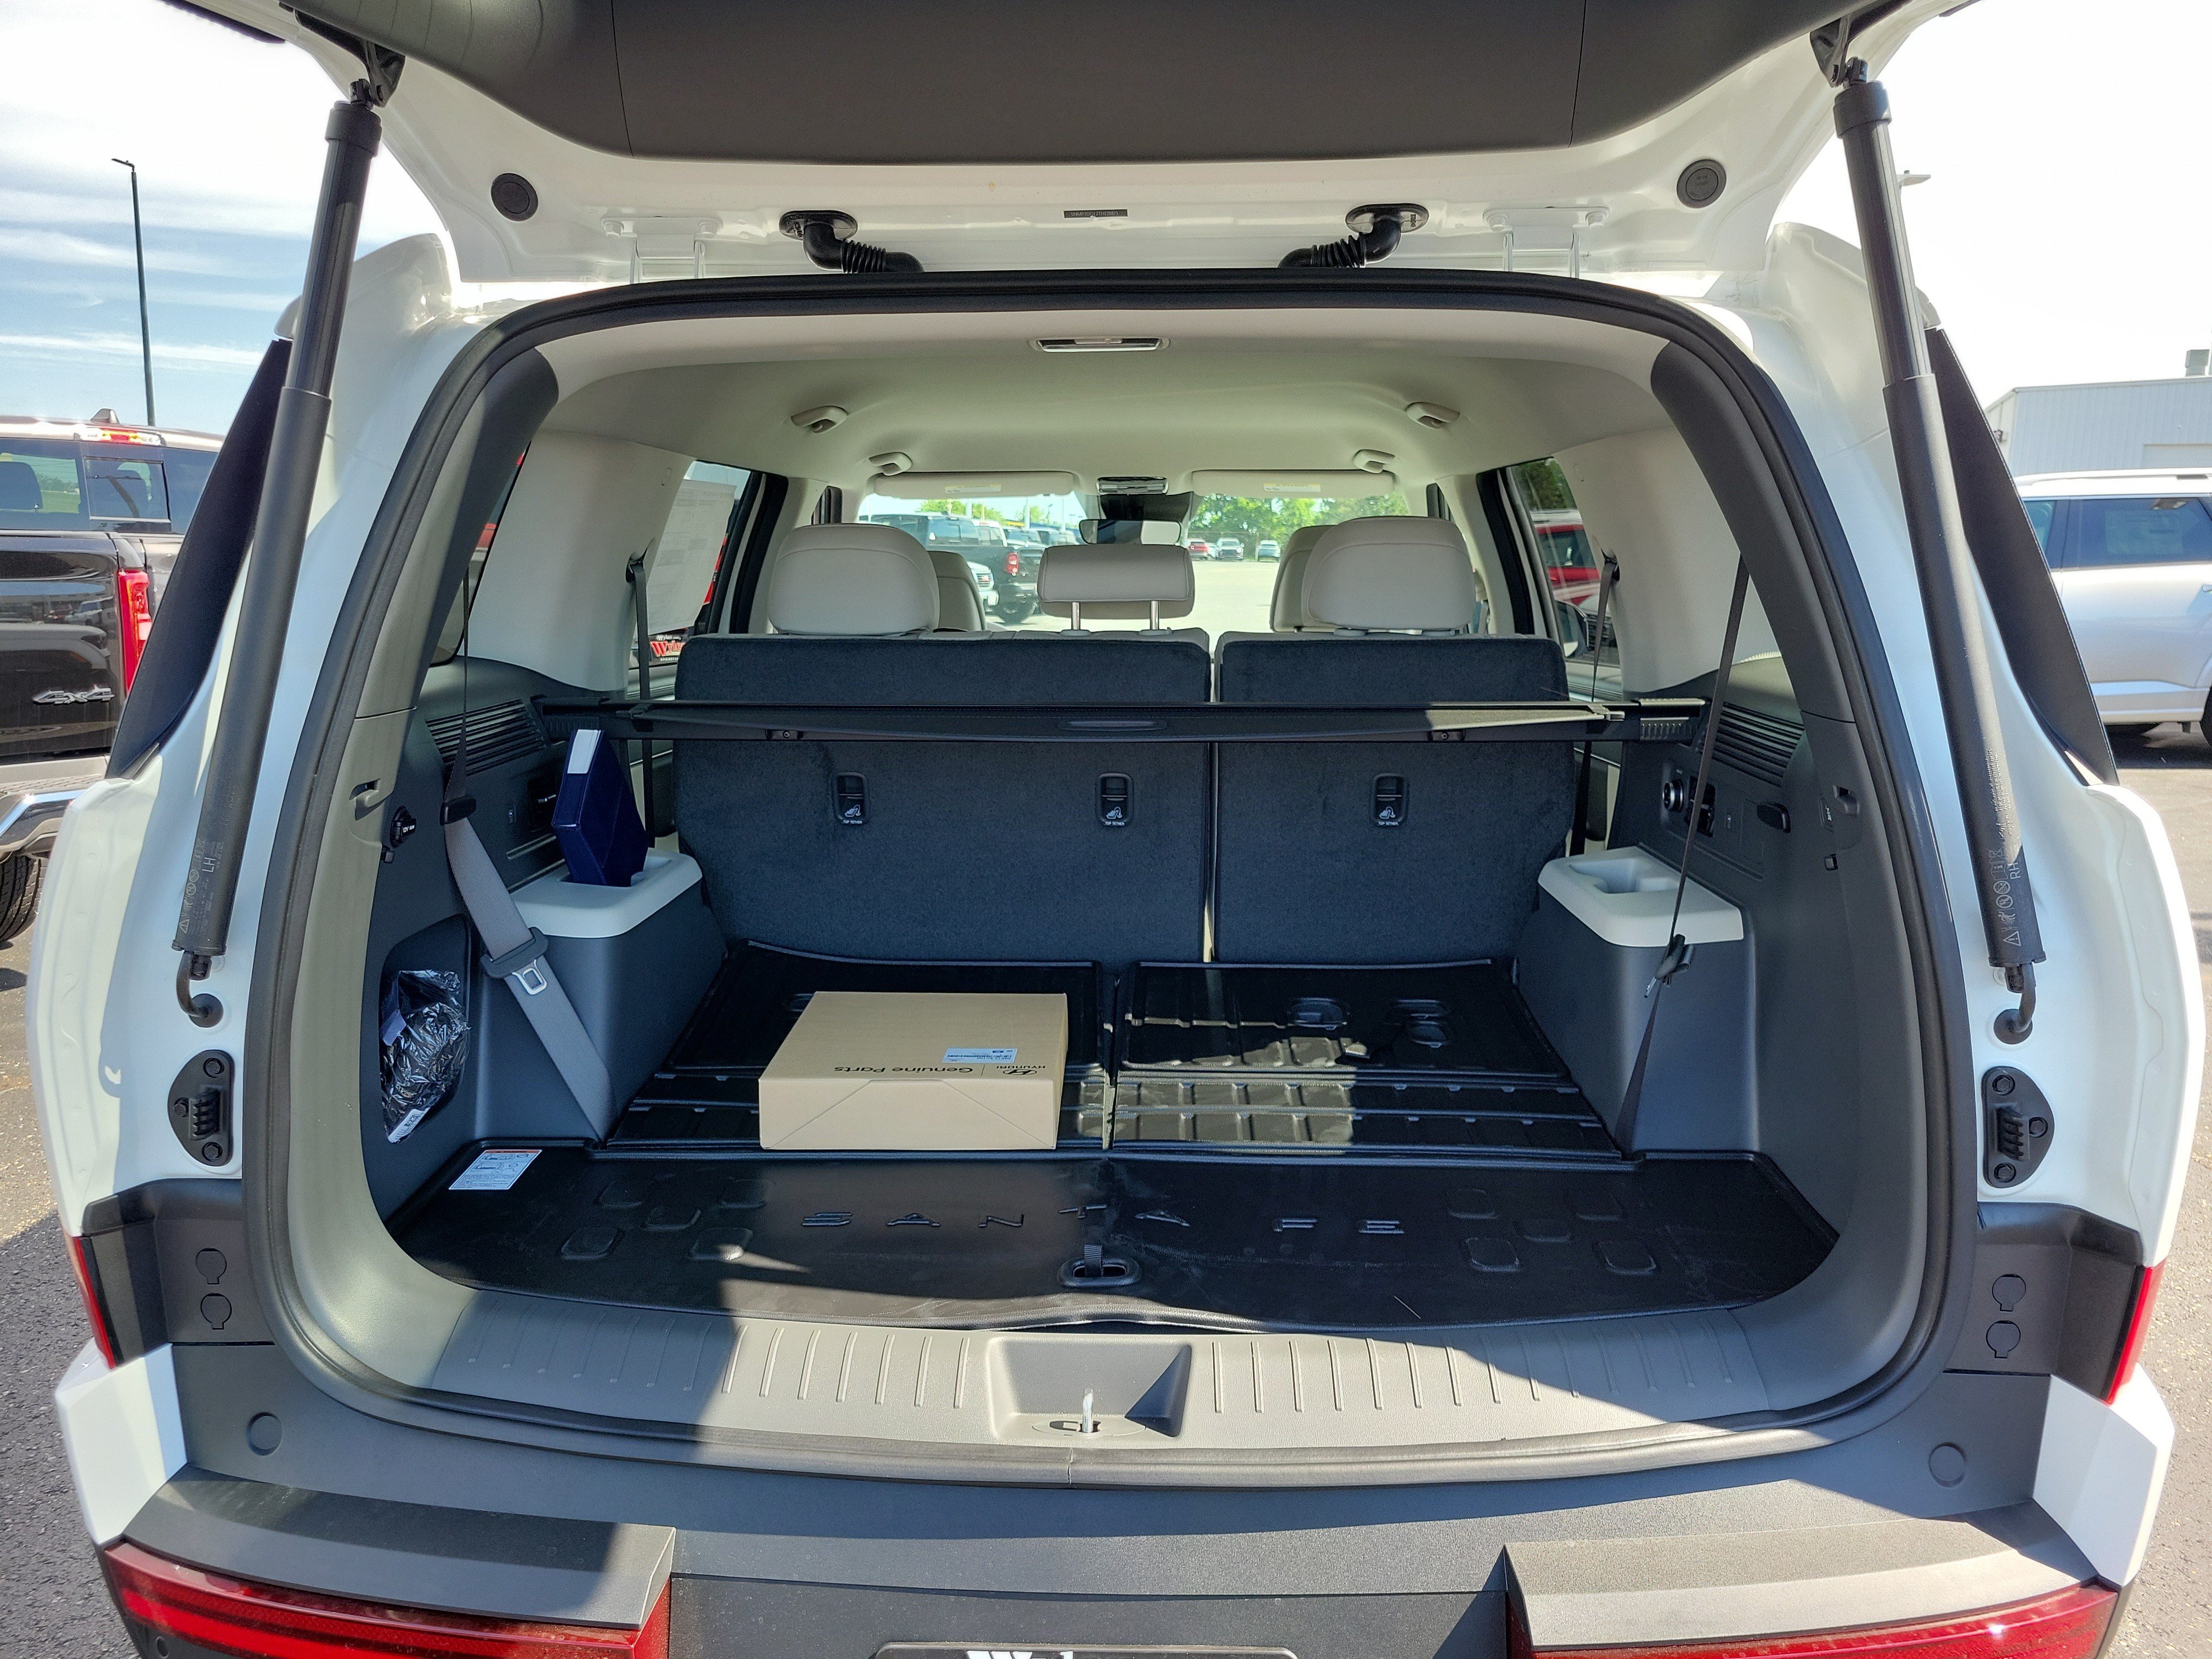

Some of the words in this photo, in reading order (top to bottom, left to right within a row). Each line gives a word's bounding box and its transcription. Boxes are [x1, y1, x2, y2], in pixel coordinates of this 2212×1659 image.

[201, 856, 216, 872] LH
[2008, 862, 2021, 879] RH
[801, 1204, 1190, 1227] SANTA
[1274, 1217, 1406, 1235] FE
